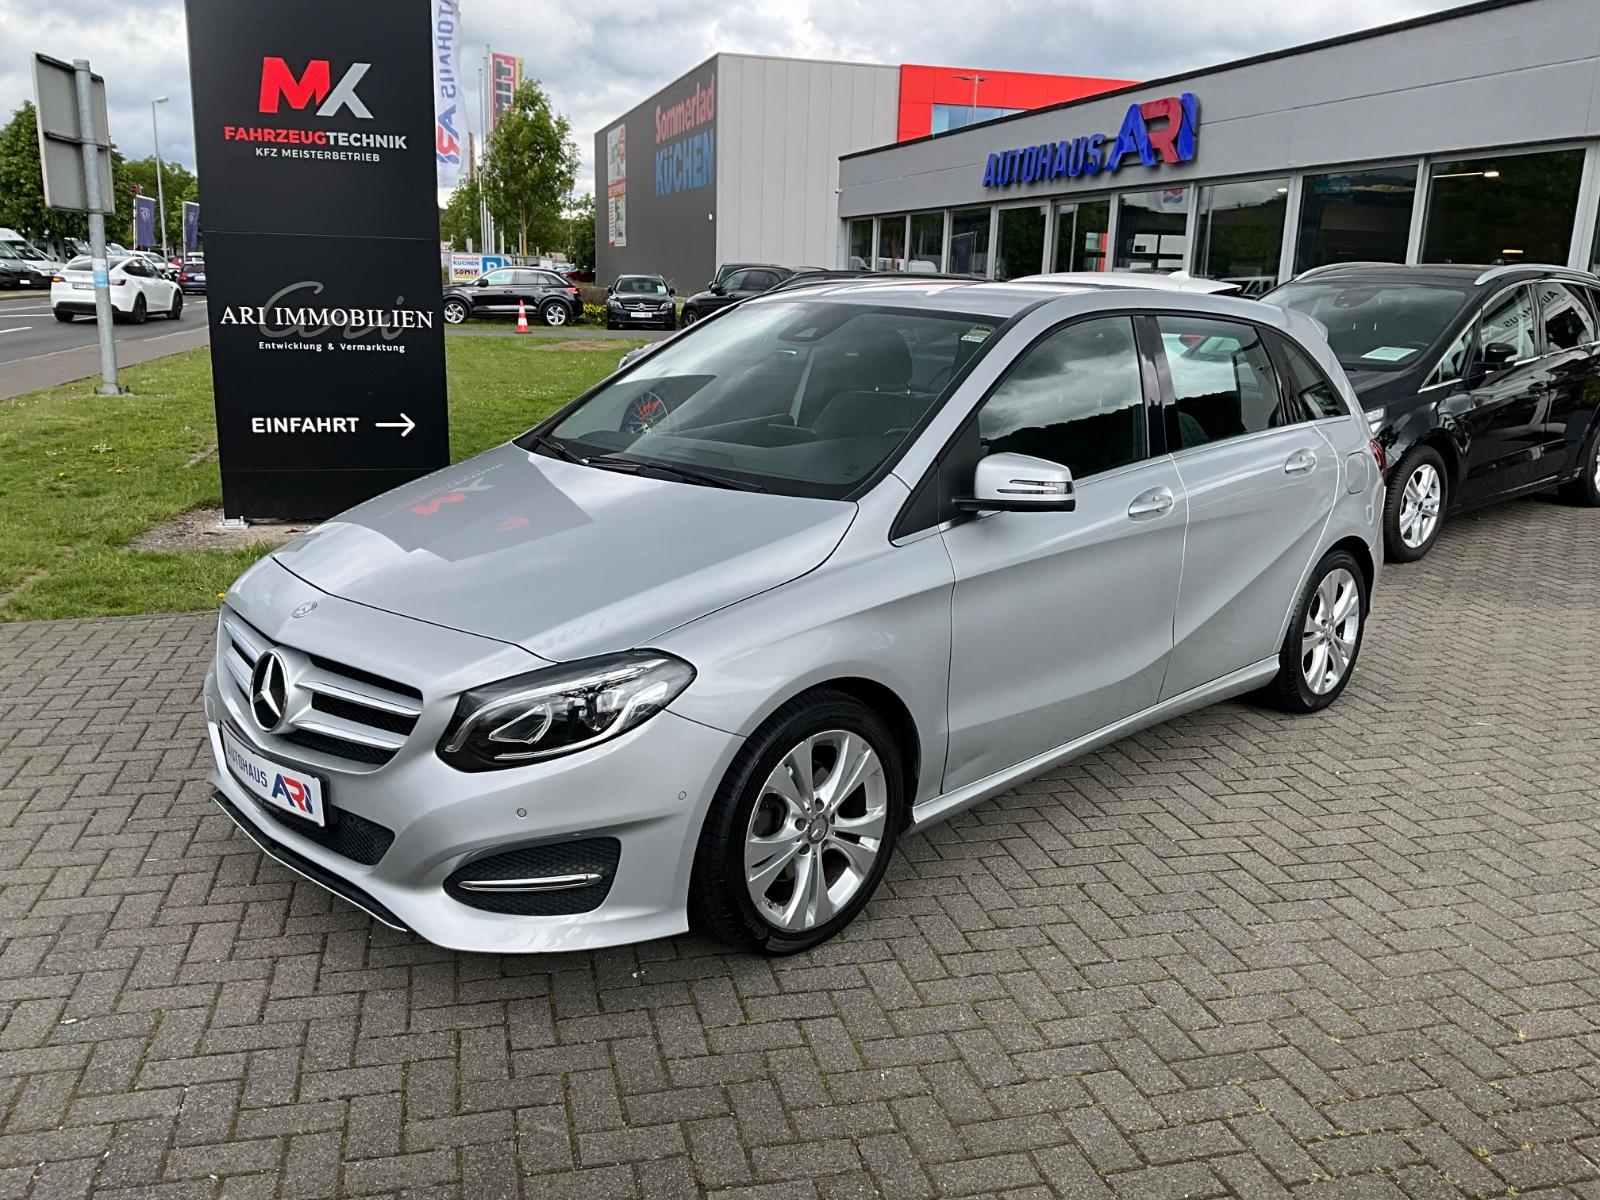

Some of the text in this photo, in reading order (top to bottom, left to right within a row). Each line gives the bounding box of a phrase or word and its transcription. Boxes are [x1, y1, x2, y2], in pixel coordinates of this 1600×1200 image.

[259, 56, 375, 119] MK
[495, 58, 513, 118] MIT
[655, 73, 715, 145] Sommerlad
[223, 126, 408, 150] FAHRZEUGTECHNIK
[255, 147, 381, 163] KFZ MEISTERBETRIEB
[982, 92, 1200, 188] AUTOHAUS ARI
[655, 128, 715, 196] KÜCHEN
[220, 306, 434, 329] ARI IMMOBILIEN
[258, 341, 406, 354] Entwicklung & Vermarktung
[251, 417, 360, 433] EINFAHRT
[271, 773, 314, 815] ARI
